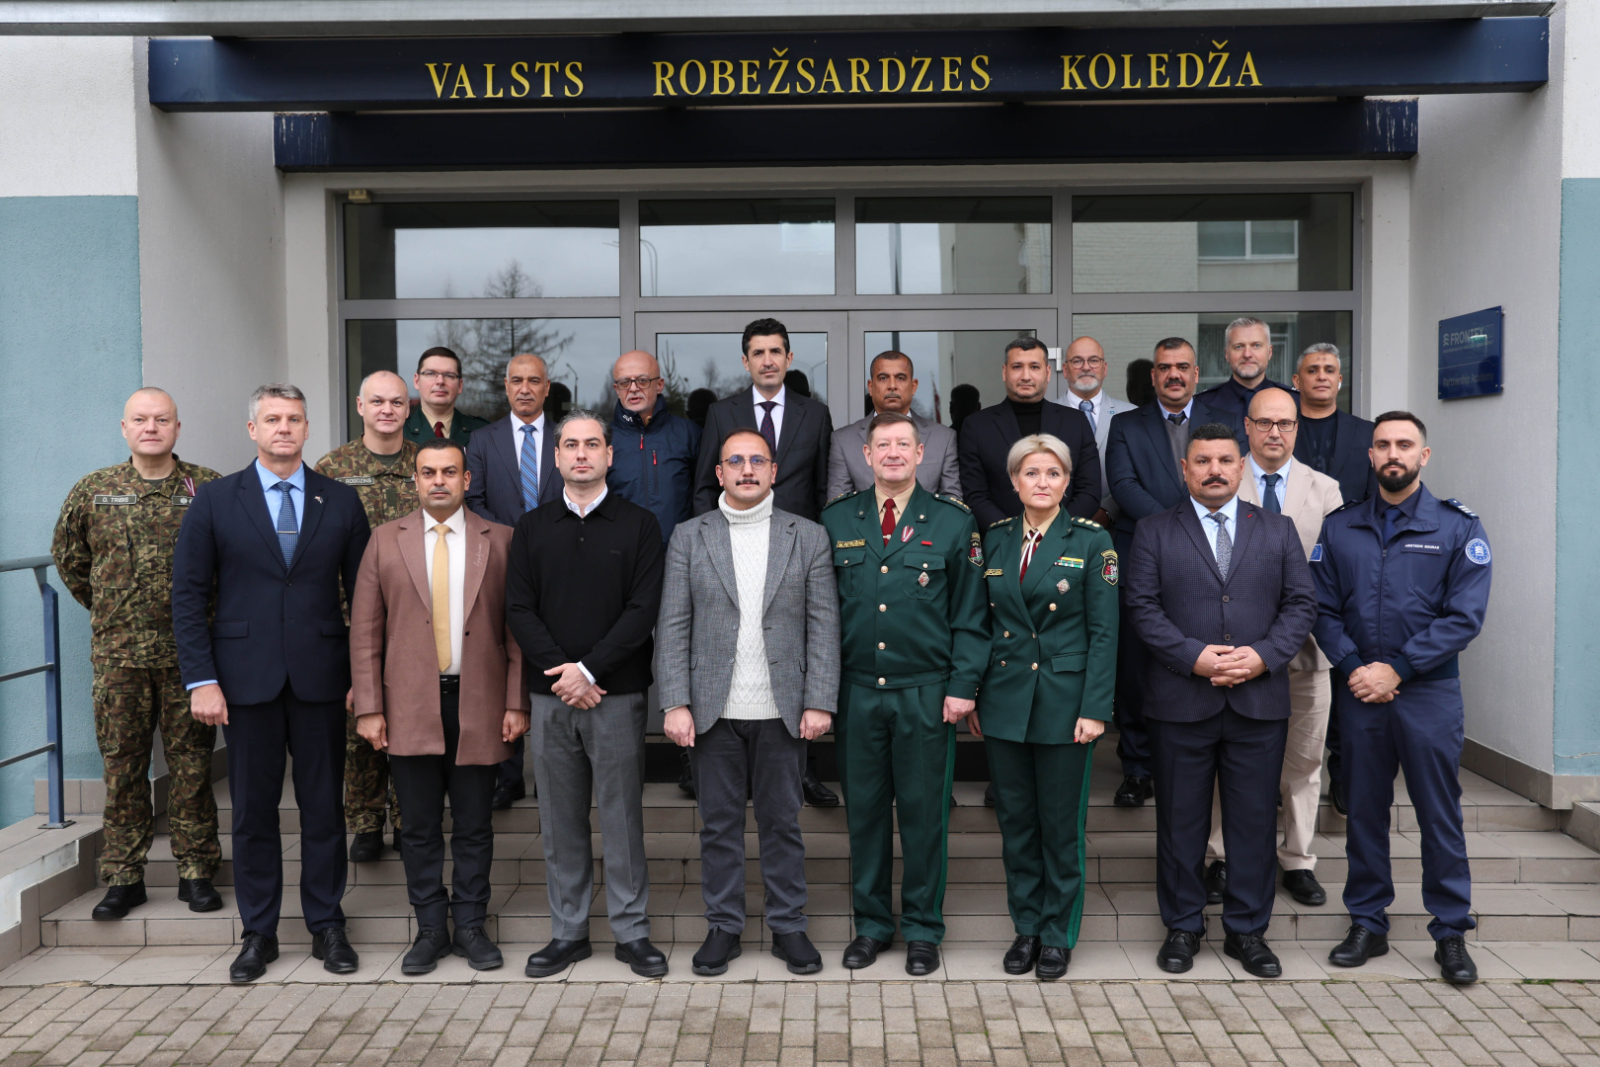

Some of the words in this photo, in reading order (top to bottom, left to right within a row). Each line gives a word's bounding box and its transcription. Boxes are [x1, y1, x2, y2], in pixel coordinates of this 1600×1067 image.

[425, 61, 584, 98] VALSTS
[652, 47, 991, 96] ROBEŽSARDZES
[1060, 40, 1263, 90] KOLEDŽA
